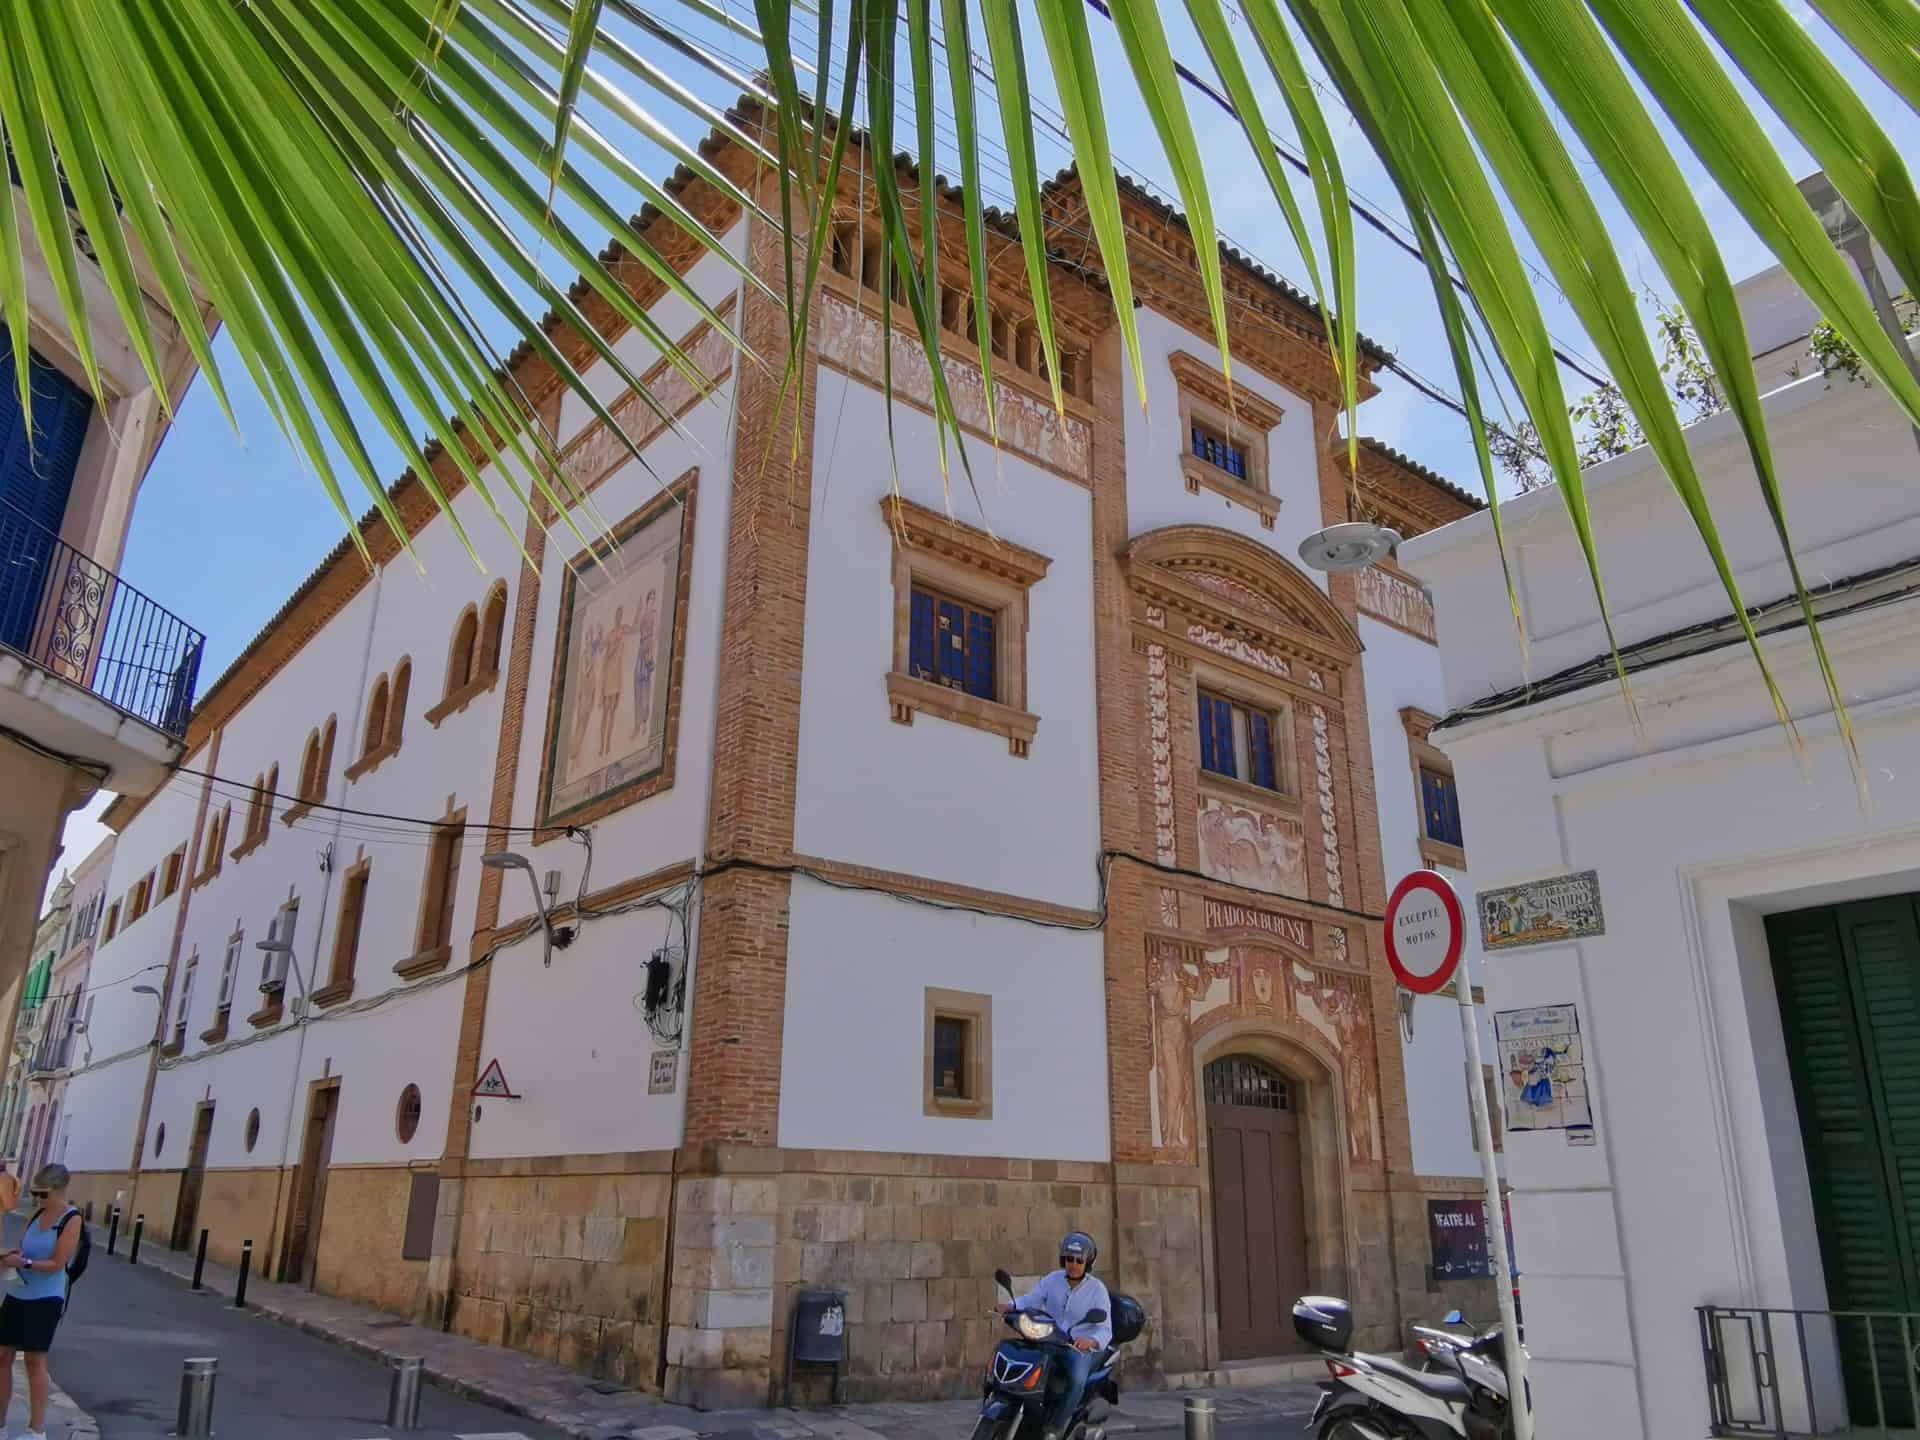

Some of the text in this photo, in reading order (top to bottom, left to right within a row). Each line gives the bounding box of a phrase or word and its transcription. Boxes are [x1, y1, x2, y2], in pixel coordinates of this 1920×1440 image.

[1205, 900, 1309, 948] PRADO SUBURENSE
[1399, 908, 1440, 926] EXCEPTE
[1406, 929, 1436, 944] MOTOS
[1434, 1213, 1463, 1226] TEATRE
